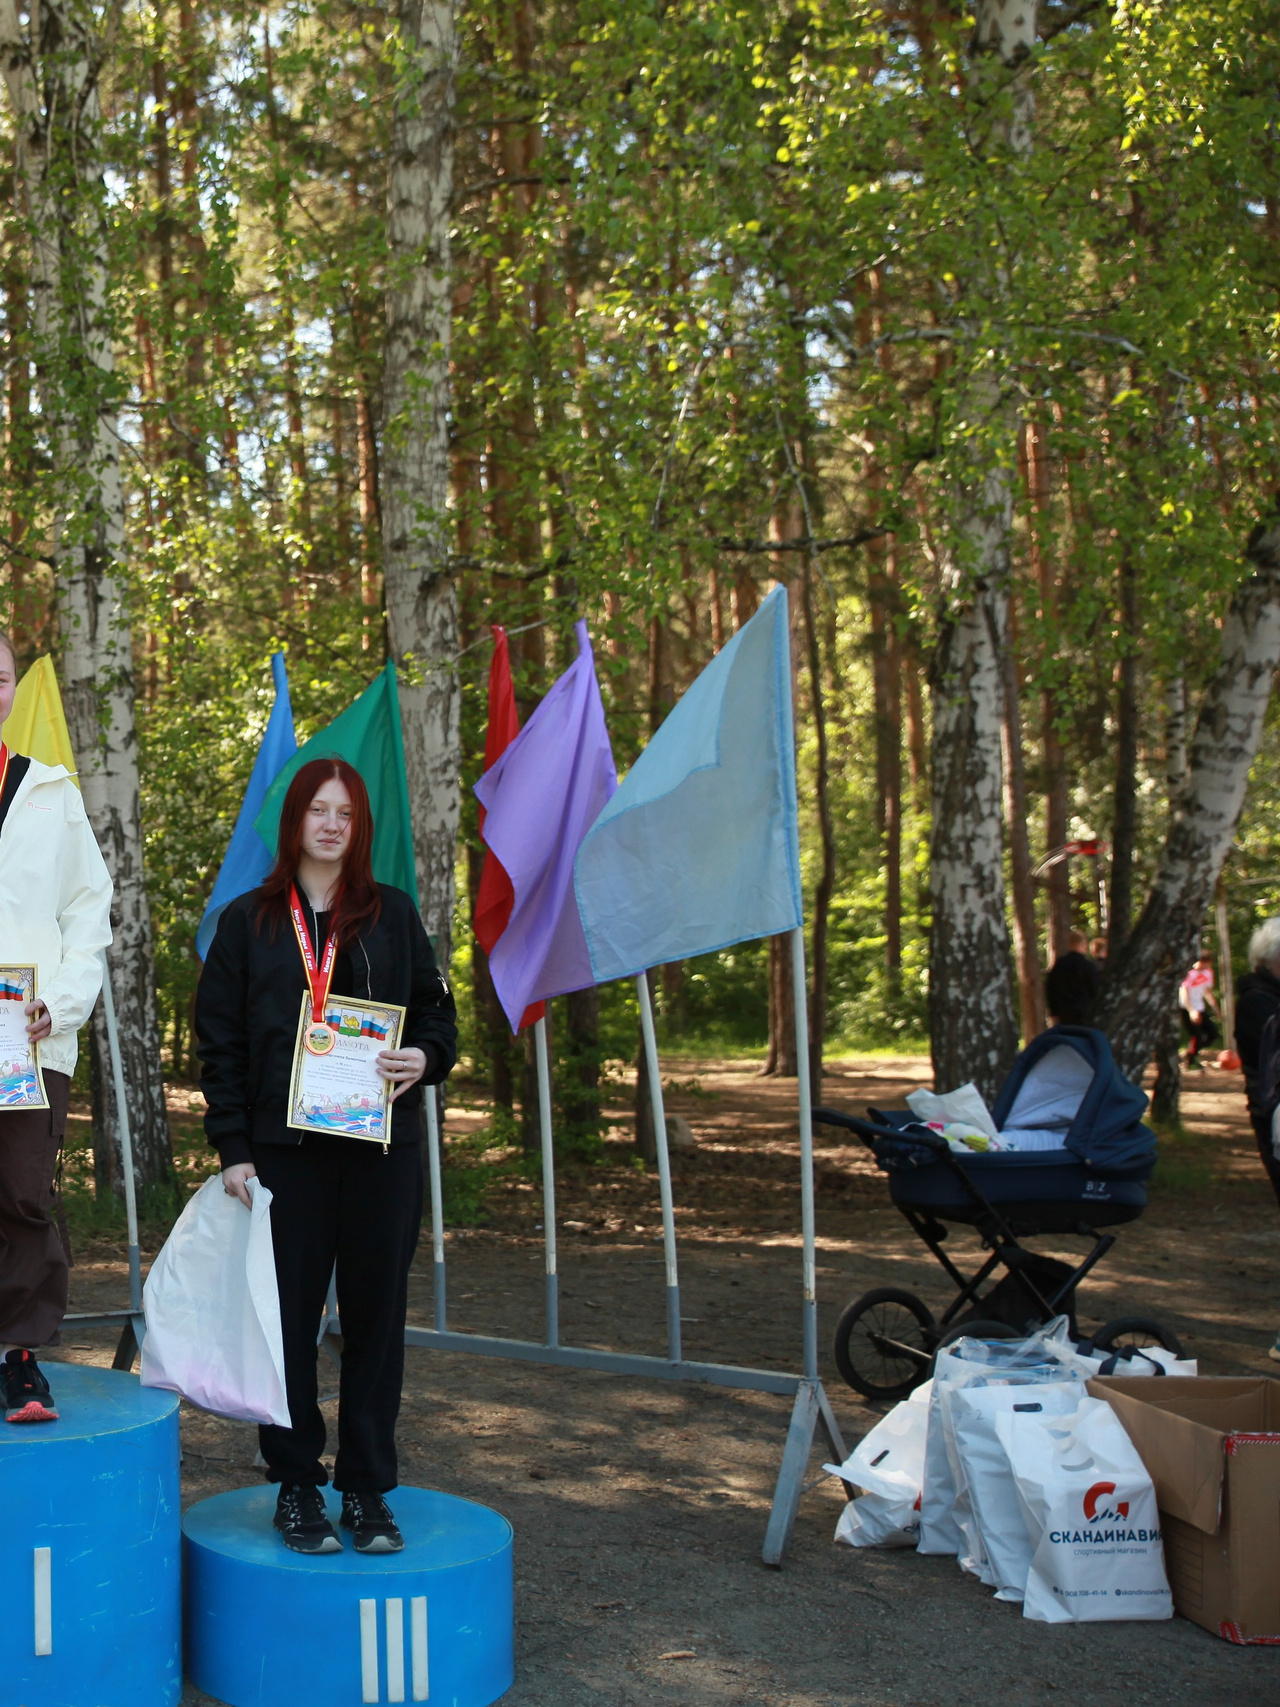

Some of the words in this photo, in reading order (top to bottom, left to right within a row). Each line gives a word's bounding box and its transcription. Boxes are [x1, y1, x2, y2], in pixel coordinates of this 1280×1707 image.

[293, 909, 301, 924] Иван
[300, 932, 309, 950] Марья
[306, 960, 314, 971] лет
[323, 956, 331, 973] Иван
[336, 1039, 370, 1051] АМОТА
[1073, 1547, 1116, 1557] спортивный
[1117, 1547, 1148, 1555] магазин
